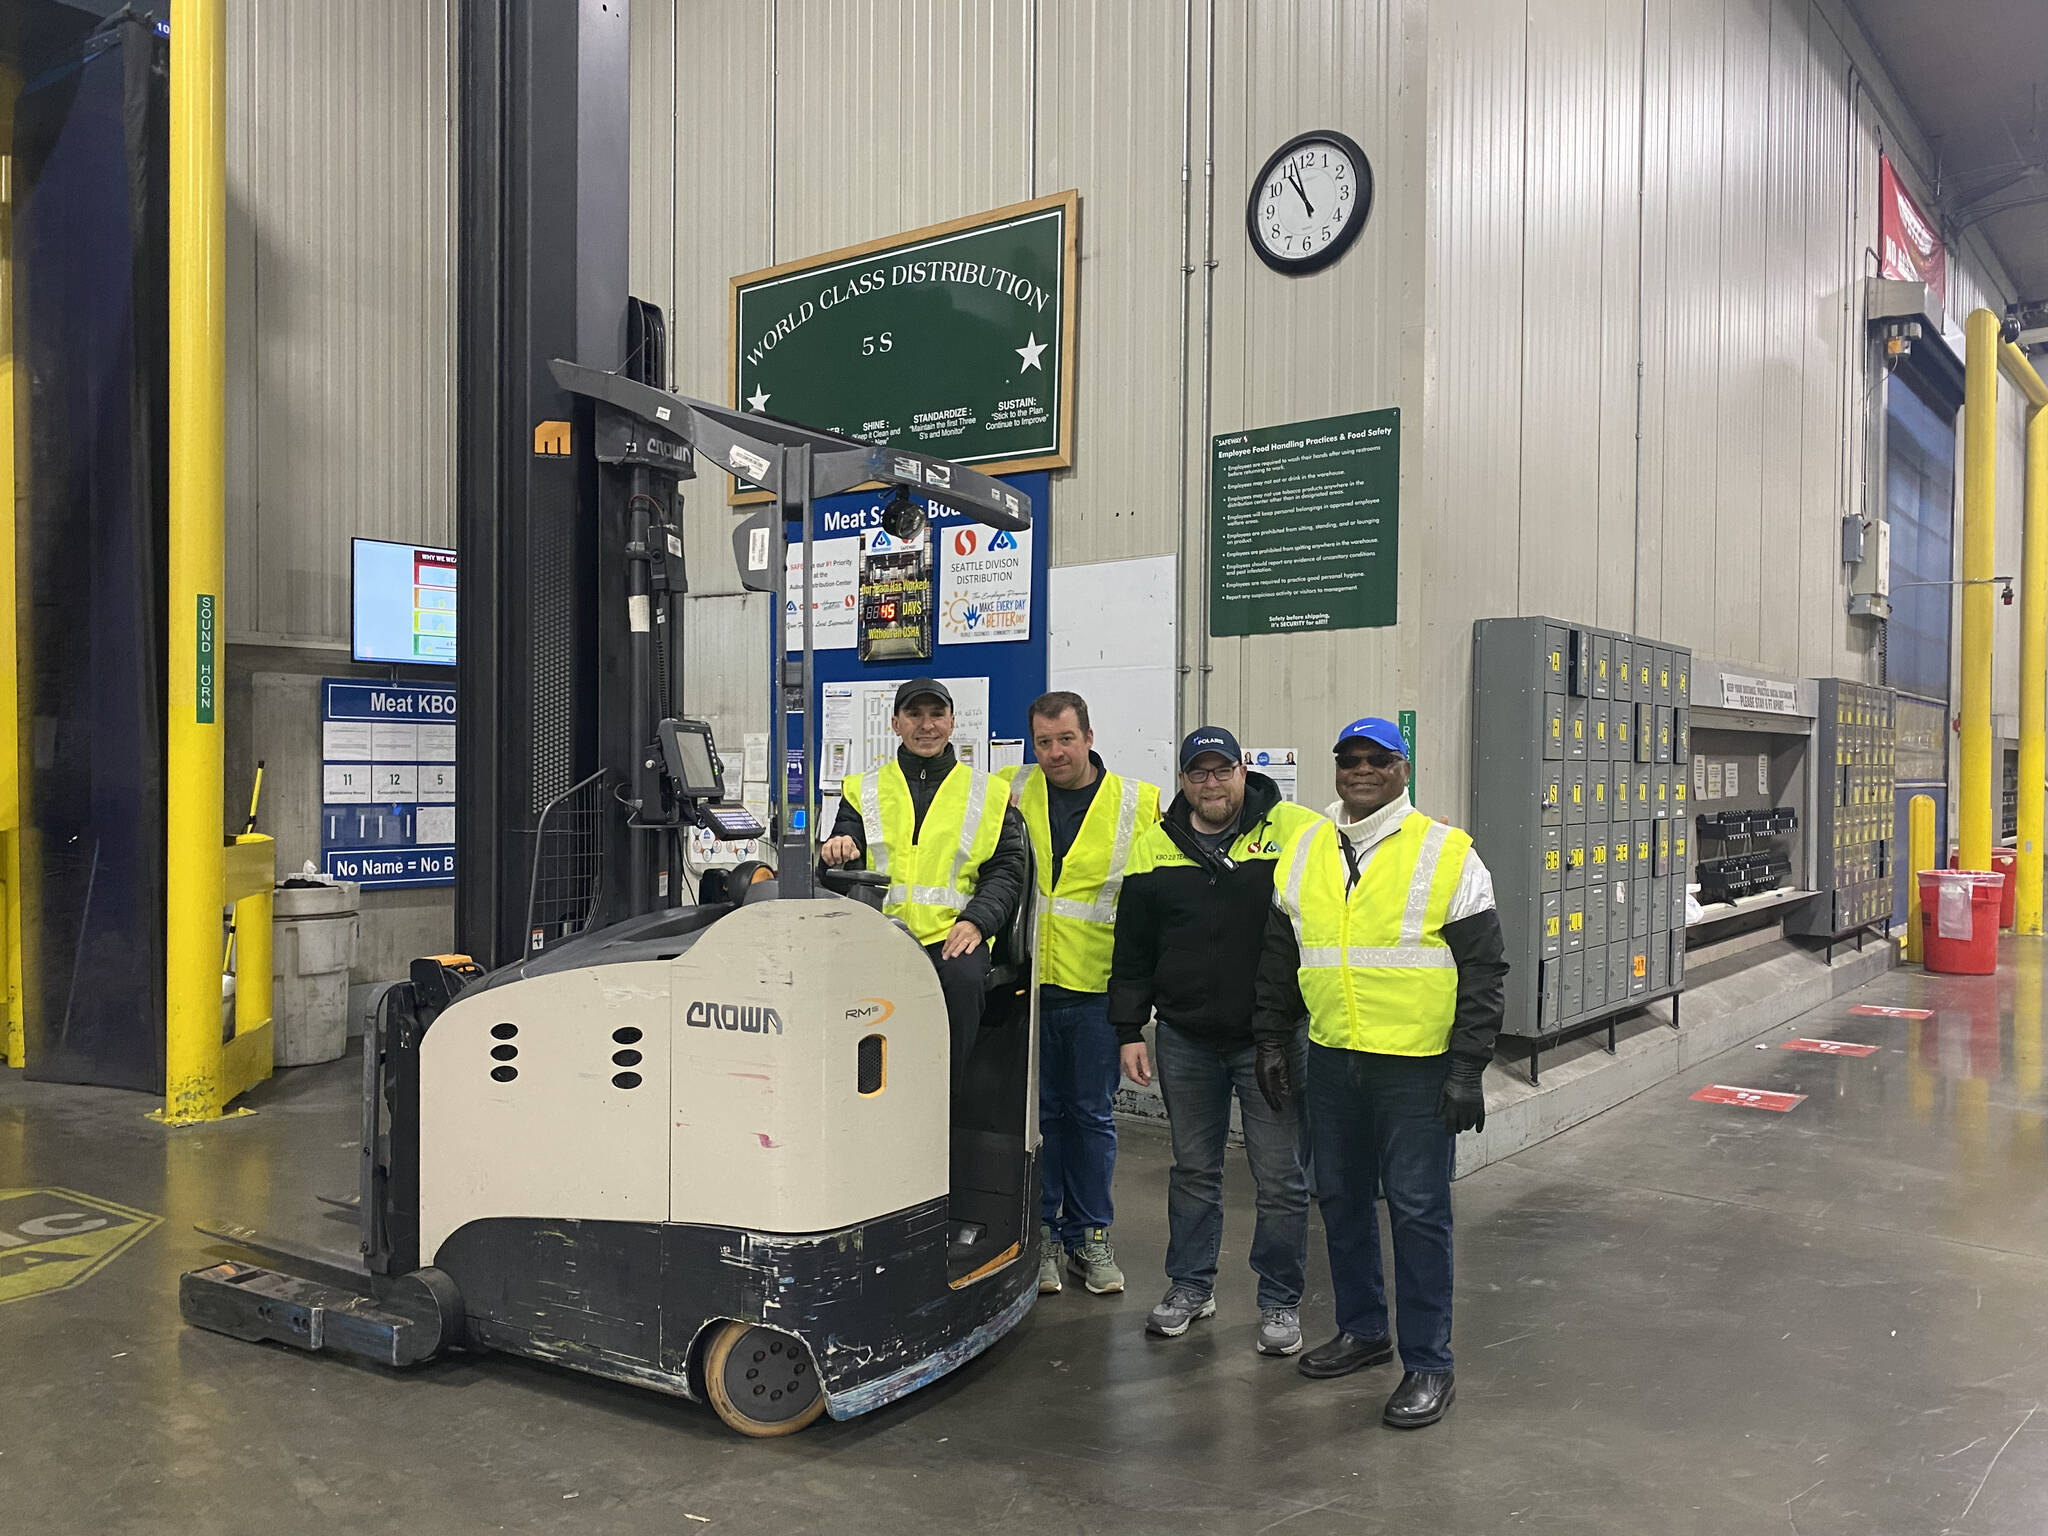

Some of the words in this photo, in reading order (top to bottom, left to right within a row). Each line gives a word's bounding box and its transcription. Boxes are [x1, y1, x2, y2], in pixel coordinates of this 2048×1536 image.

[1299, 152, 1315, 169] 12
[1322, 153, 1328, 168] 1
[1282, 163, 1295, 180] 11
[1335, 164, 1345, 180] 2
[1269, 181, 1283, 198] 10
[1340, 185, 1349, 200] 3
[1266, 205, 1275, 220] 9
[1332, 207, 1343, 222] 4
[1271, 224, 1280, 239] 8
[1321, 225, 1331, 241] 5
[1284, 235, 1293, 250] 7
[1302, 236, 1312, 251] 6
[746, 301, 814, 367] WORLD
[819, 269, 885, 310] CLASS
[892, 261, 1050, 313] DISTRIBUTION
[998, 396, 1037, 411] SUSTAIN:
[1009, 410, 1017, 418] to
[1017, 408, 1027, 417] the
[1029, 406, 1043, 416] Plan
[936, 421, 945, 430] the
[947, 420, 958, 428] first
[959, 417, 976, 426] Three
[985, 420, 1013, 431] Continue
[1013, 418, 1020, 427] to
[873, 430, 889, 438] Clean
[890, 427, 901, 436] and
[929, 429, 940, 438] and
[1218, 437, 1242, 447] SAFEWAY
[1218, 448, 1251, 459] Employee
[1252, 444, 1270, 453] Food
[1271, 440, 1304, 451] Handling
[1306, 435, 1338, 445] Practices
[1339, 433, 1346, 441] &
[1347, 429, 1366, 439] Food
[1368, 426, 1392, 437] Safety
[647, 438, 692, 463] CROWN
[824, 509, 866, 532] Meat
[833, 559, 852, 567] Priority
[951, 561, 983, 573] SEATTLE
[985, 557, 1019, 570] DIVISON
[957, 571, 1012, 585] DISTRIBUTION
[861, 584, 872, 595] Our
[891, 582, 902, 592] Has
[902, 601, 922, 616] DAYS
[979, 601, 994, 612] MAKE
[996, 600, 1014, 611] EVERY
[1015, 599, 1026, 610] DAY
[201, 597, 212, 653] SOUND
[986, 611, 1016, 628] BETTER
[1016, 614, 1026, 623] DAY
[1280, 620, 1305, 628] SECURITY
[903, 626, 920, 638] OSHA
[201, 664, 212, 709] HORN
[370, 692, 413, 713] Meat
[1740, 695, 1754, 708] PLEASE
[343, 774, 352, 786] 11
[389, 774, 400, 786] 12
[437, 774, 443, 785] 5
[337, 860, 358, 876] No
[362, 859, 404, 875] Name
[421, 857, 440, 872] No
[444, 856, 454, 871] B
[686, 1001, 783, 1035] CROWN
